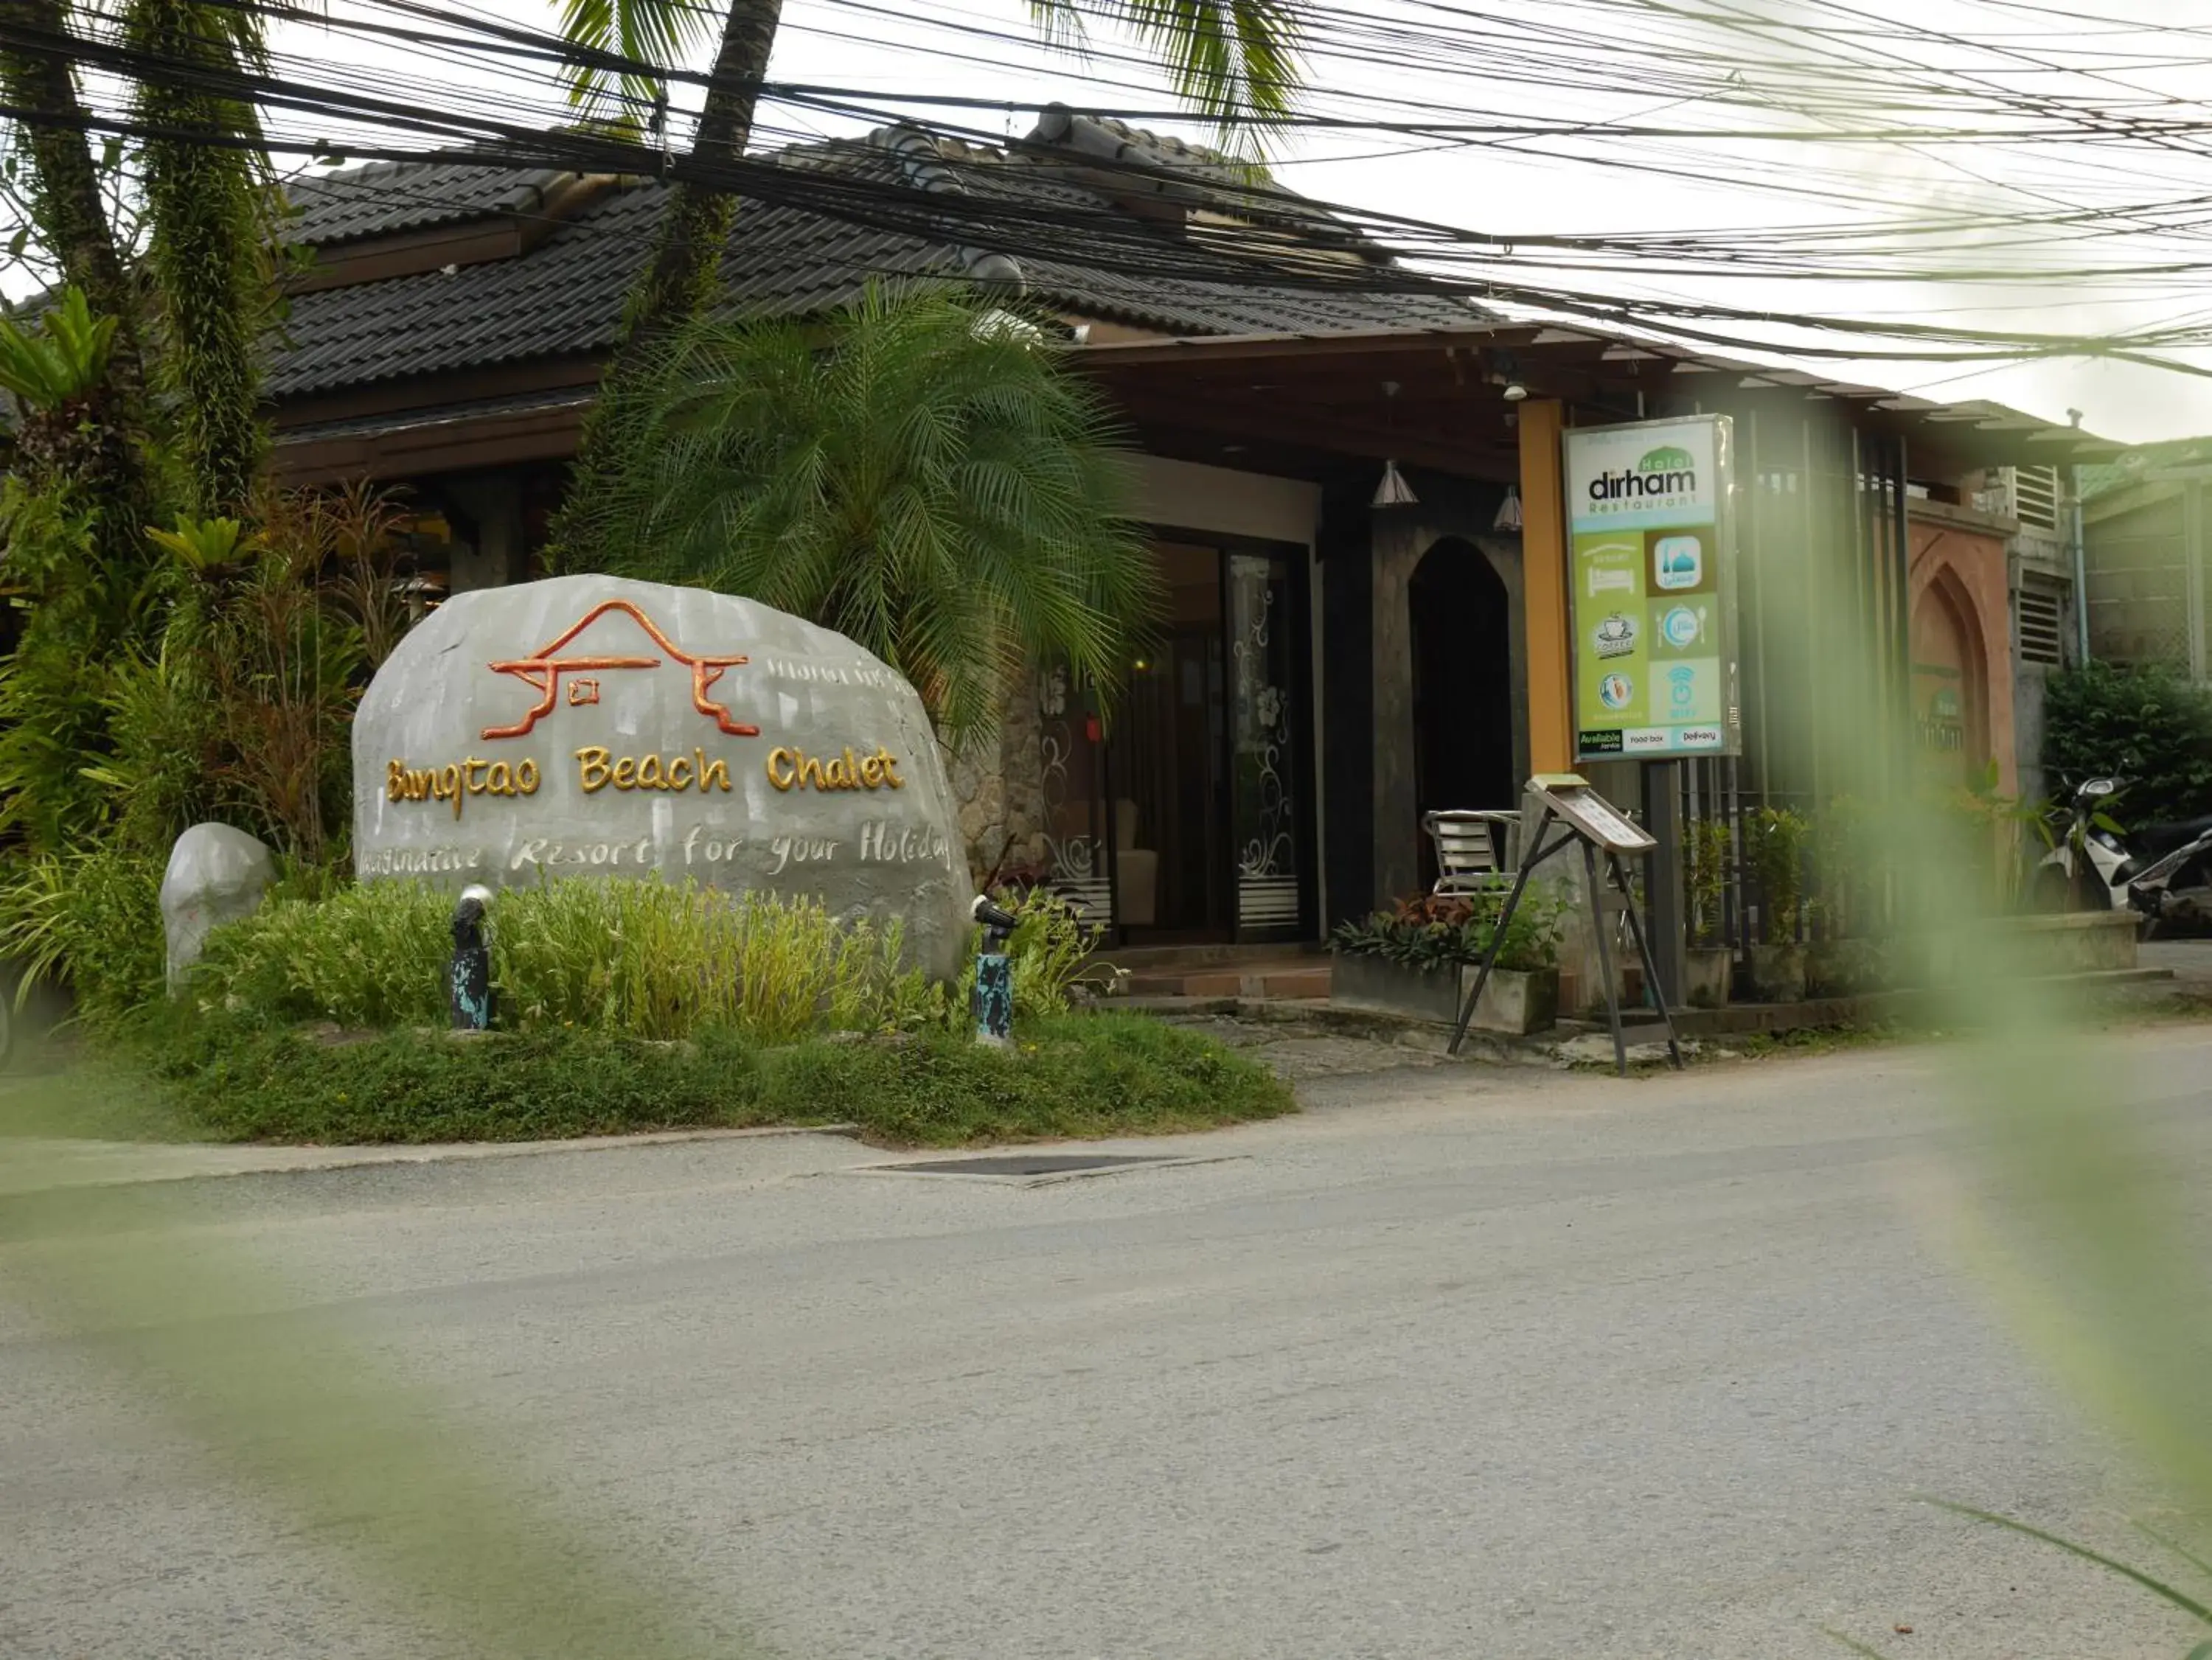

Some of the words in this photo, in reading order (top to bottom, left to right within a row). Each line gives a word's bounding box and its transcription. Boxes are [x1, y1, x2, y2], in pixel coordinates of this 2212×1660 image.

[1641, 456, 1691, 471] Halal
[1589, 469, 1696, 501] dirham
[1588, 495, 1697, 515] Restaurant
[1649, 734, 1664, 743] box
[1683, 730, 1717, 742] Delivery
[386, 755, 541, 822] Bangtao
[573, 744, 733, 794] Beach
[767, 745, 906, 793] Chalet
[511, 837, 655, 871] Resort
[682, 823, 743, 865] for
[768, 836, 841, 876] your
[860, 820, 952, 871] Holiday
